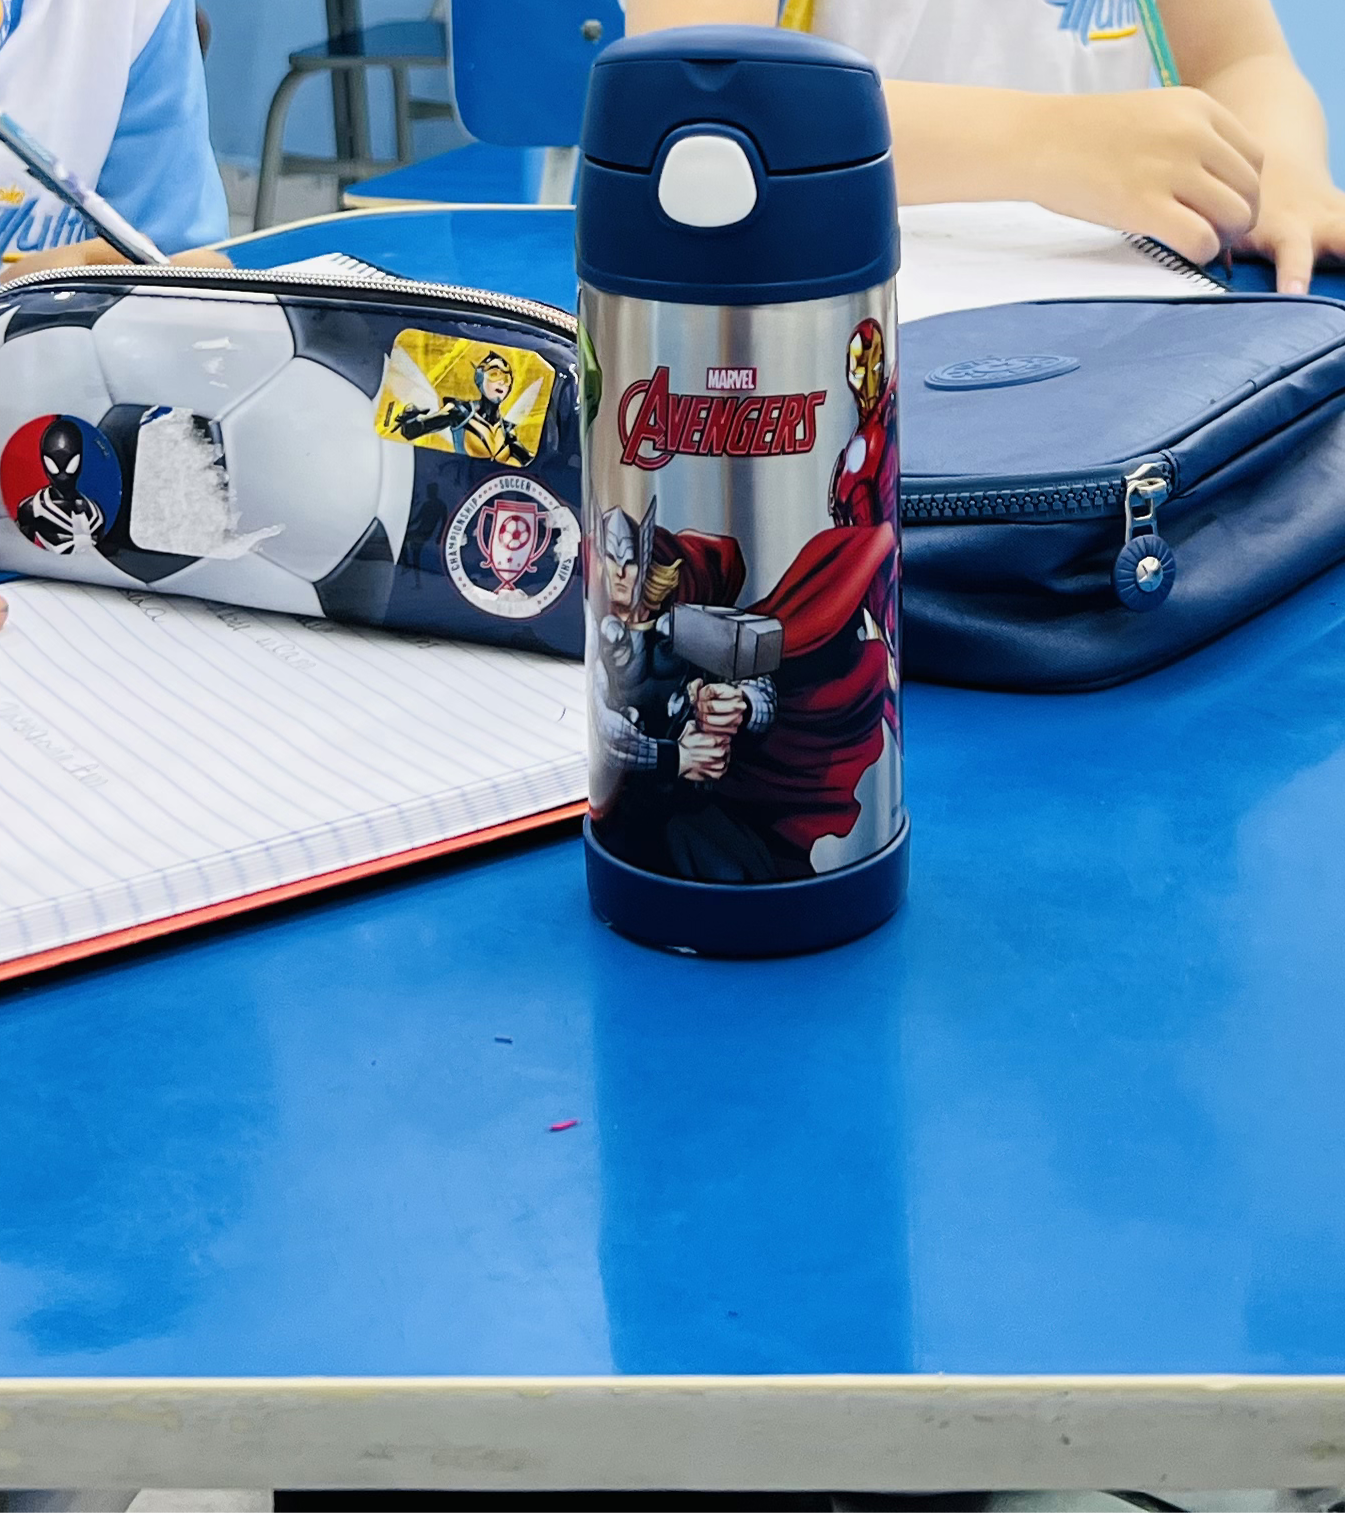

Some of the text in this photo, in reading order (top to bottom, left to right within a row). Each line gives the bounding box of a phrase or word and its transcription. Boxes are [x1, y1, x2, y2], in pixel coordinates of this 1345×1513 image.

[707, 368, 756, 390] MARVEL
[618, 365, 828, 472] AVENGERS
[499, 477, 533, 492] SOCCER
[447, 497, 479, 572] CHAMPIONSHIP
